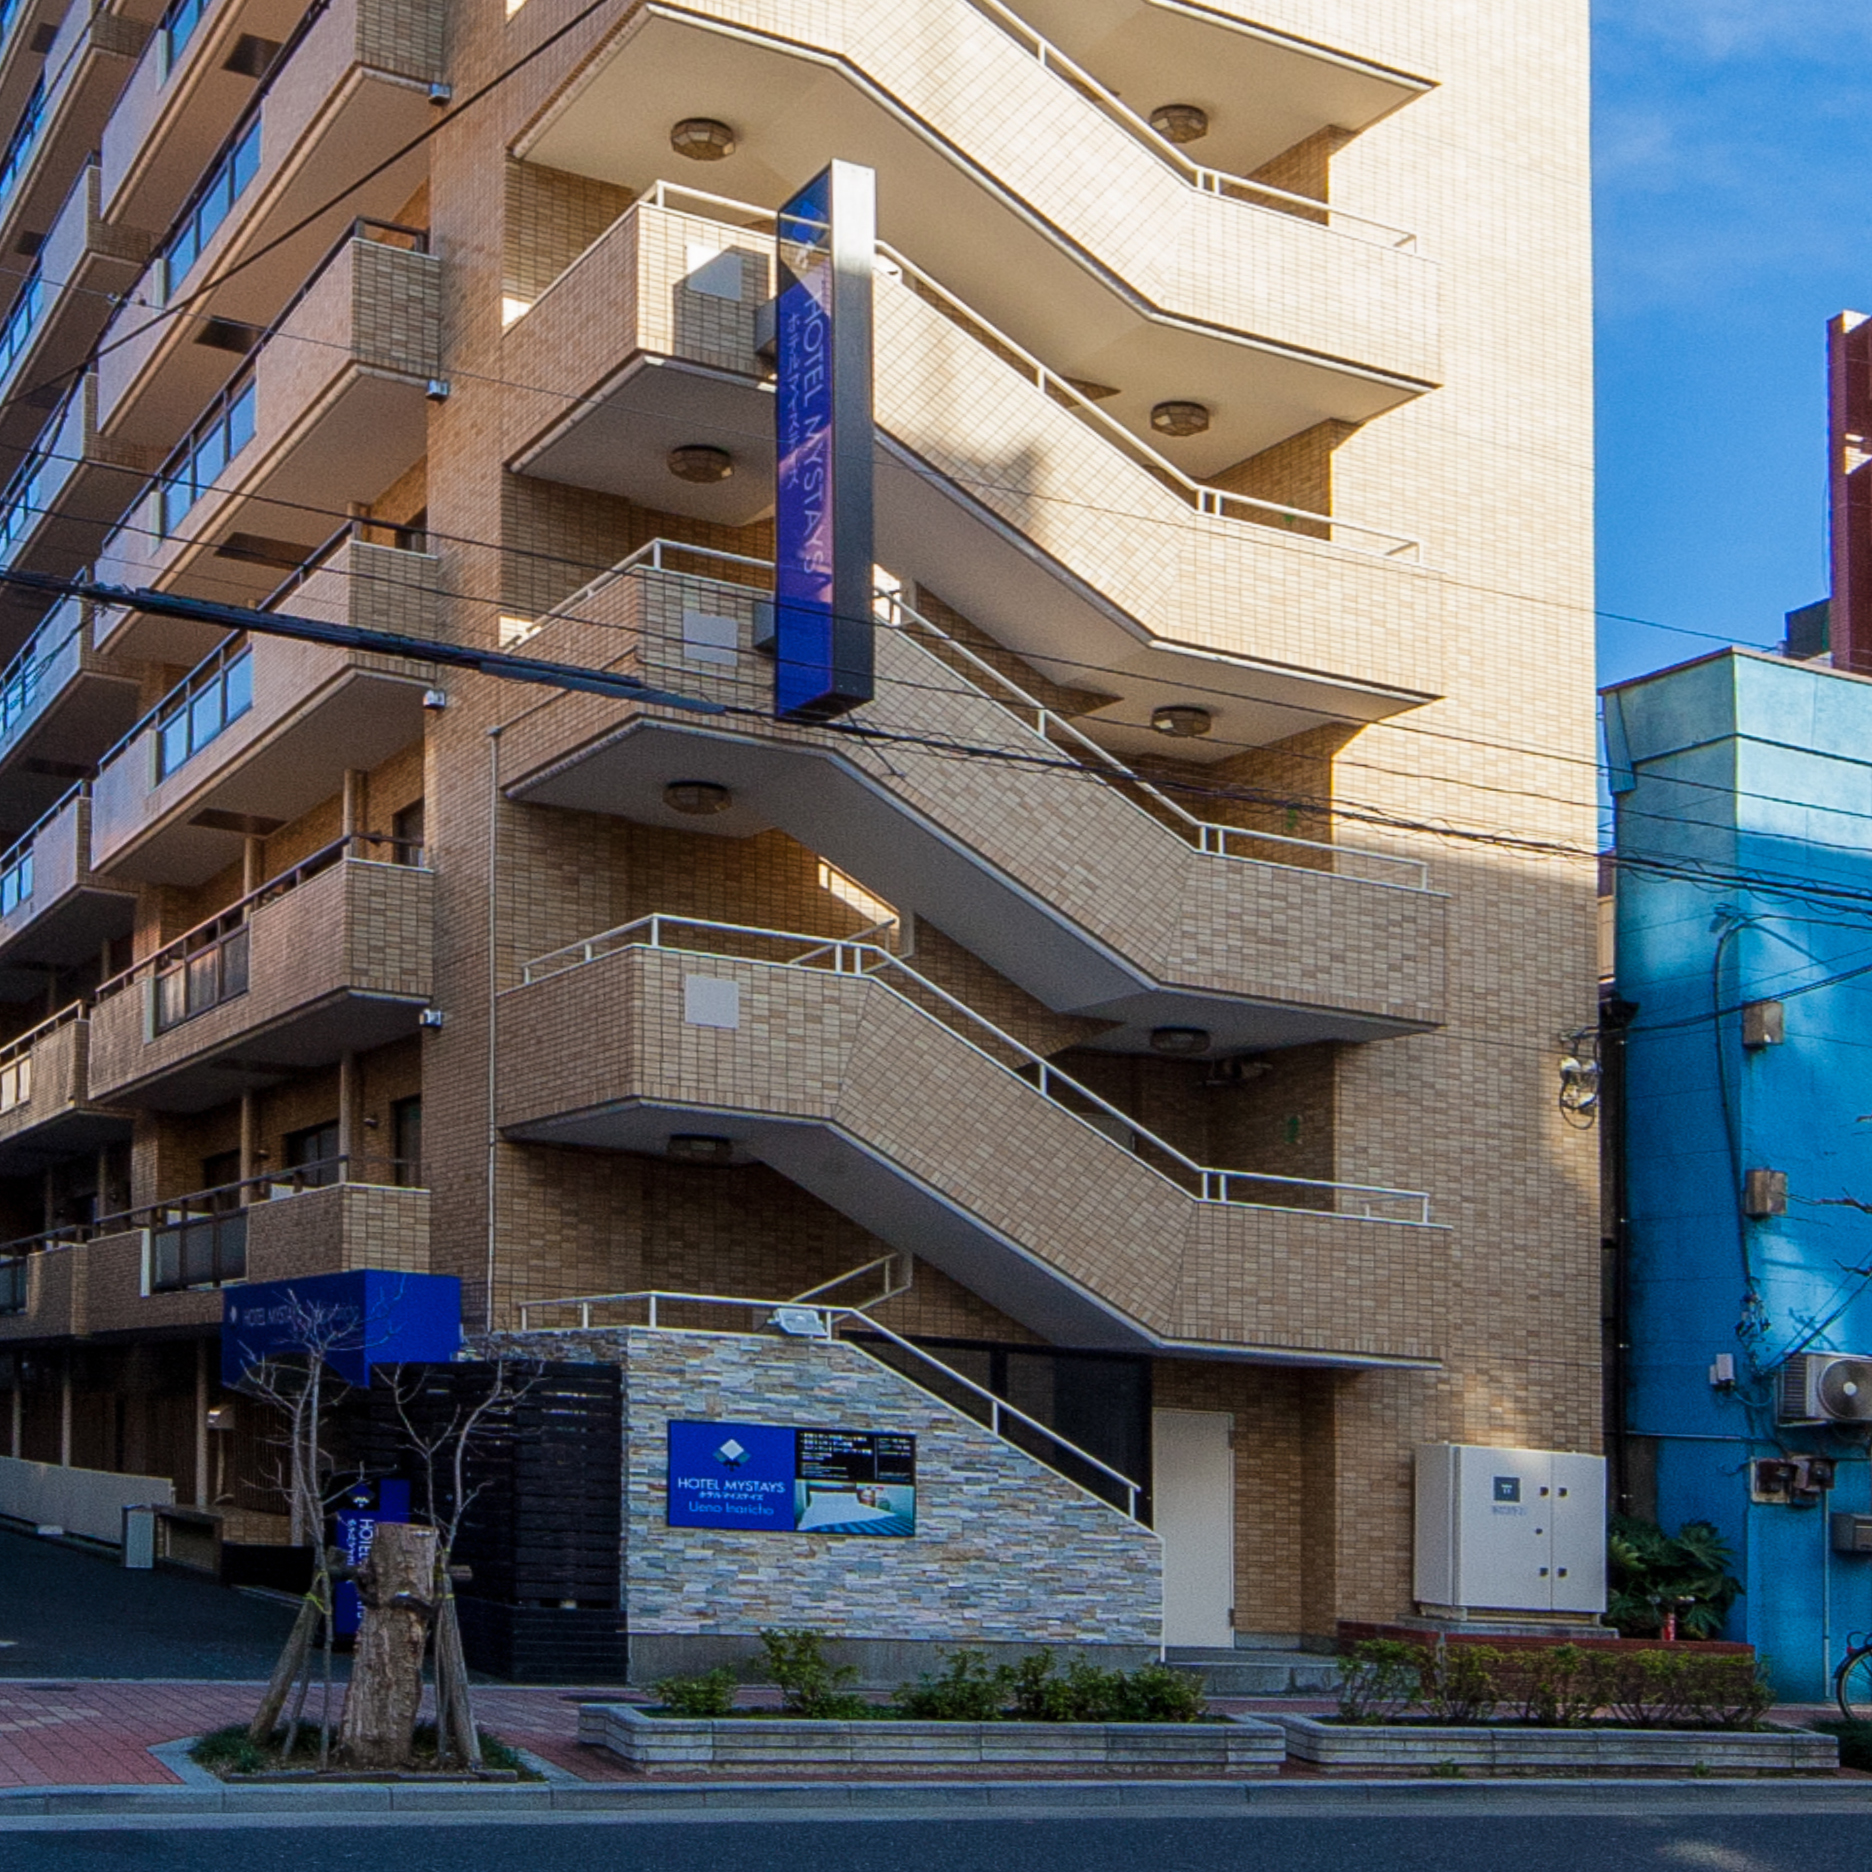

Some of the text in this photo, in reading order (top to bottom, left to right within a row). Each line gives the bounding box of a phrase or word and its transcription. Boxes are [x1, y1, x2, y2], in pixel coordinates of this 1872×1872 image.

[803, 291, 825, 574] HOTEL MYSTAYS
[677, 1476, 786, 1493] HOTEL MYSTAYS
[688, 1500, 723, 1513] Ueno
